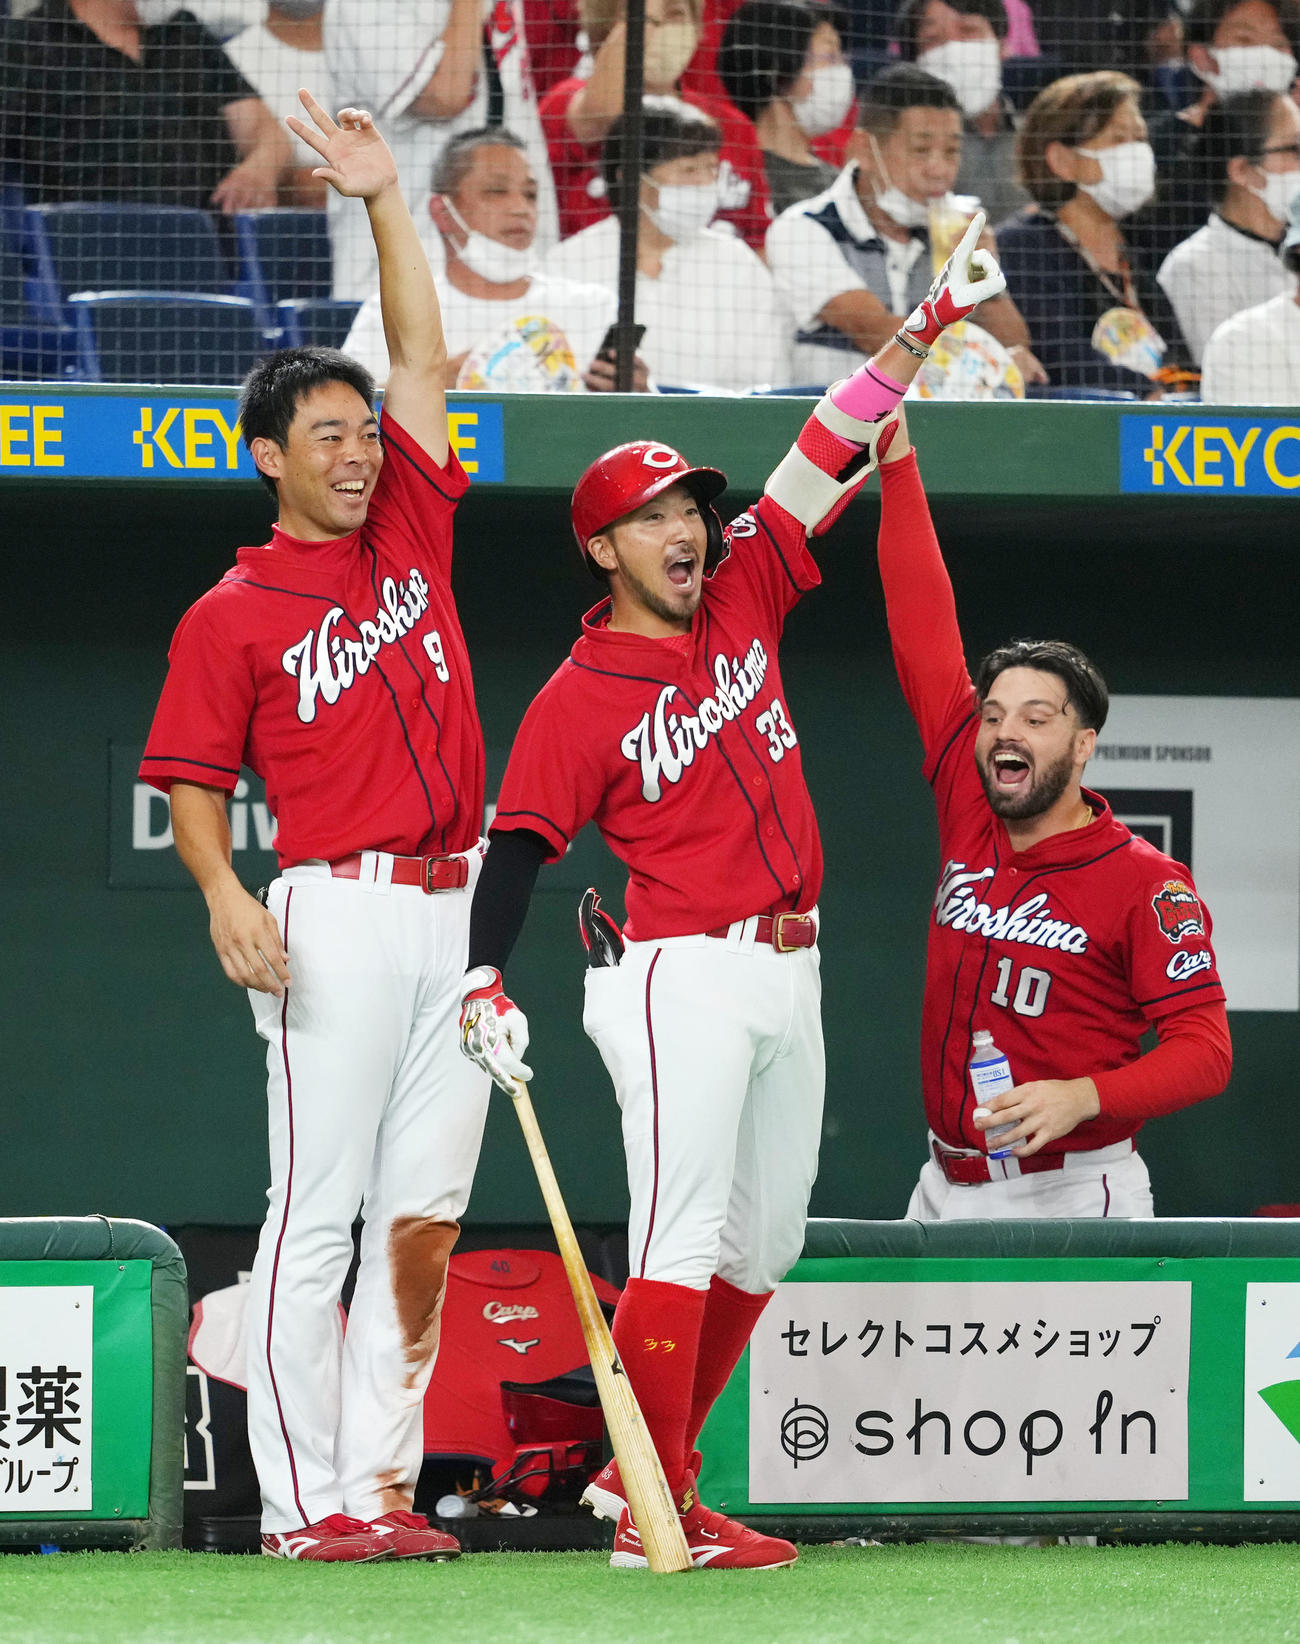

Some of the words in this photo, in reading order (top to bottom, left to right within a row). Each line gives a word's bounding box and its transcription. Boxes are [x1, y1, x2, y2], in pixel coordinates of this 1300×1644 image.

[422, 630, 450, 683] 9
[621, 638, 768, 802] Hiroshima
[755, 698, 798, 763] 33
[935, 859, 1089, 954] Hiroshima
[990, 957, 1052, 1018] 10
[482, 1301, 539, 1324] Carp
[781, 1315, 1162, 1359] セレクトコスメショップ
[0, 1366, 82, 1449] 薬
[854, 1397, 1064, 1476] shop
[0, 1456, 80, 1493] ループ
